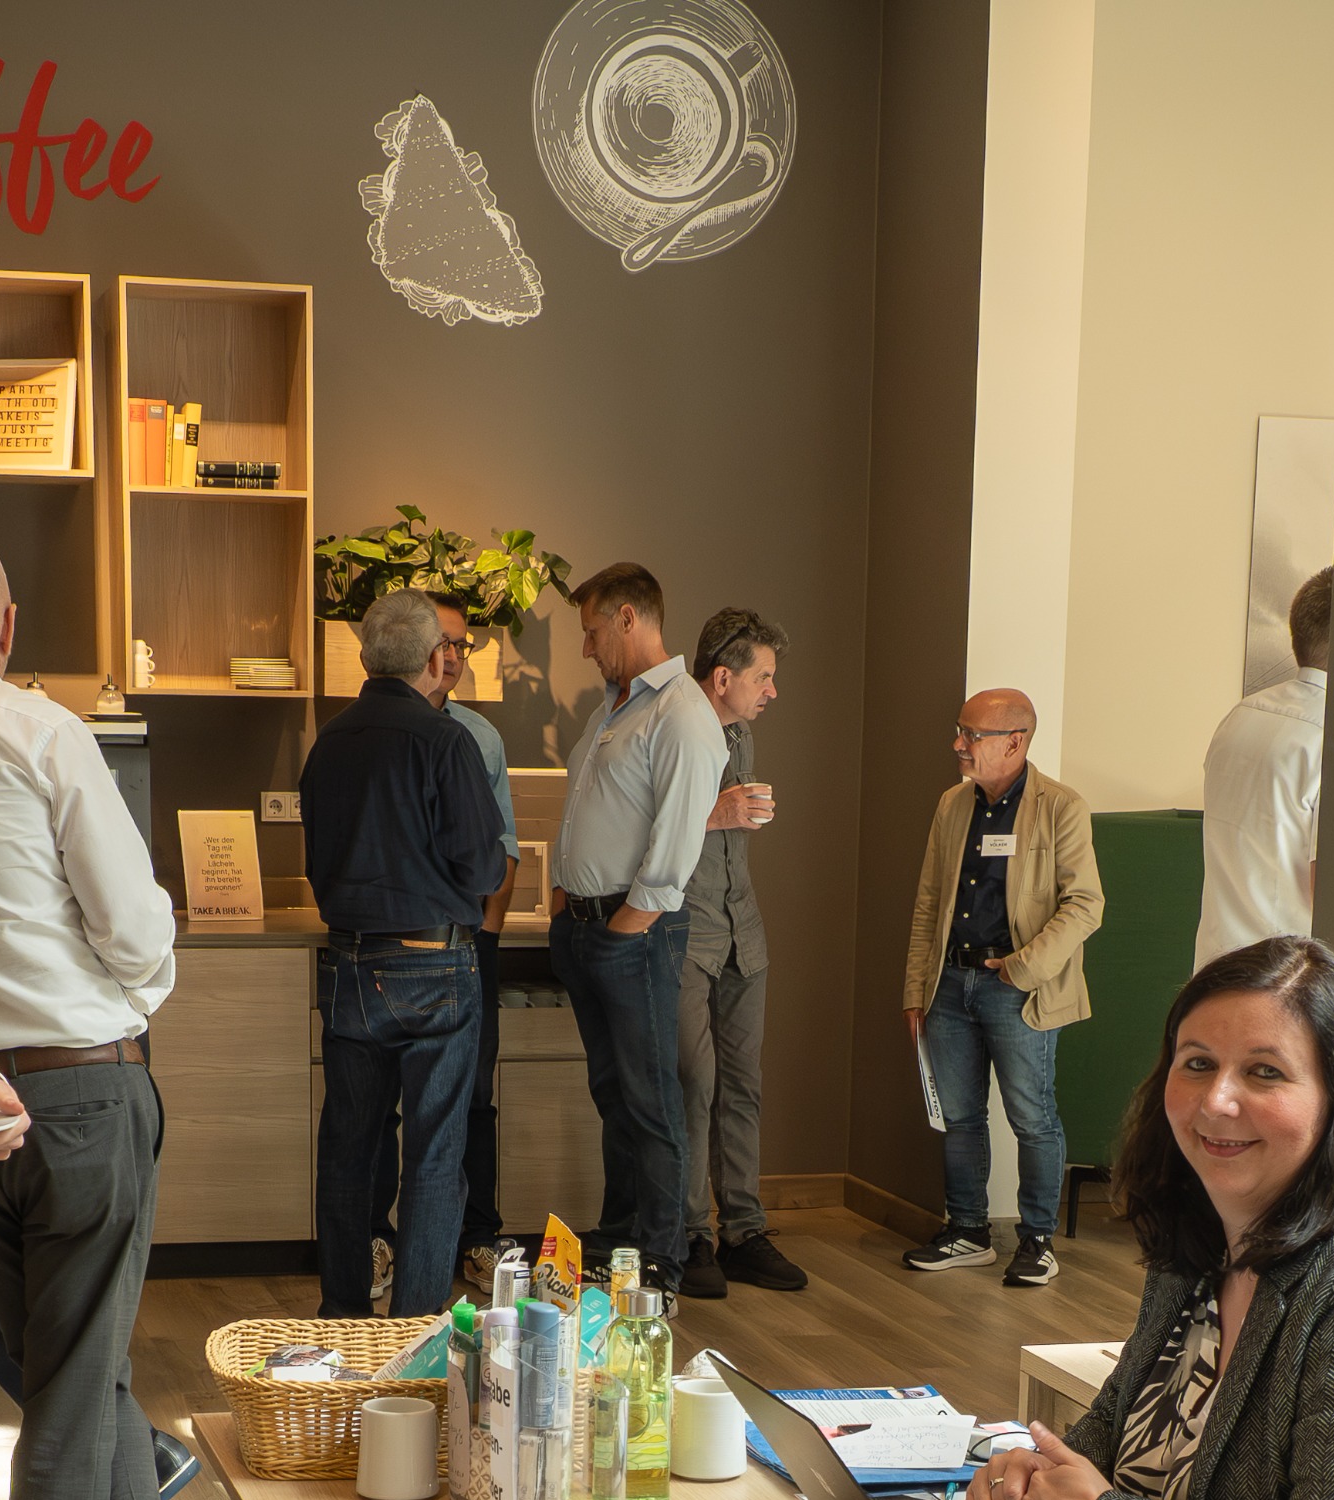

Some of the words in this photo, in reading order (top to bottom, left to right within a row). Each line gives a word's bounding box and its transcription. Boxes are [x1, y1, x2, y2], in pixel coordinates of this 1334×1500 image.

[32, 398, 56, 407] OUT
[3, 425, 35, 434] JUST
[192, 907, 214, 915] TAKE
[215, 907, 222, 915] A
